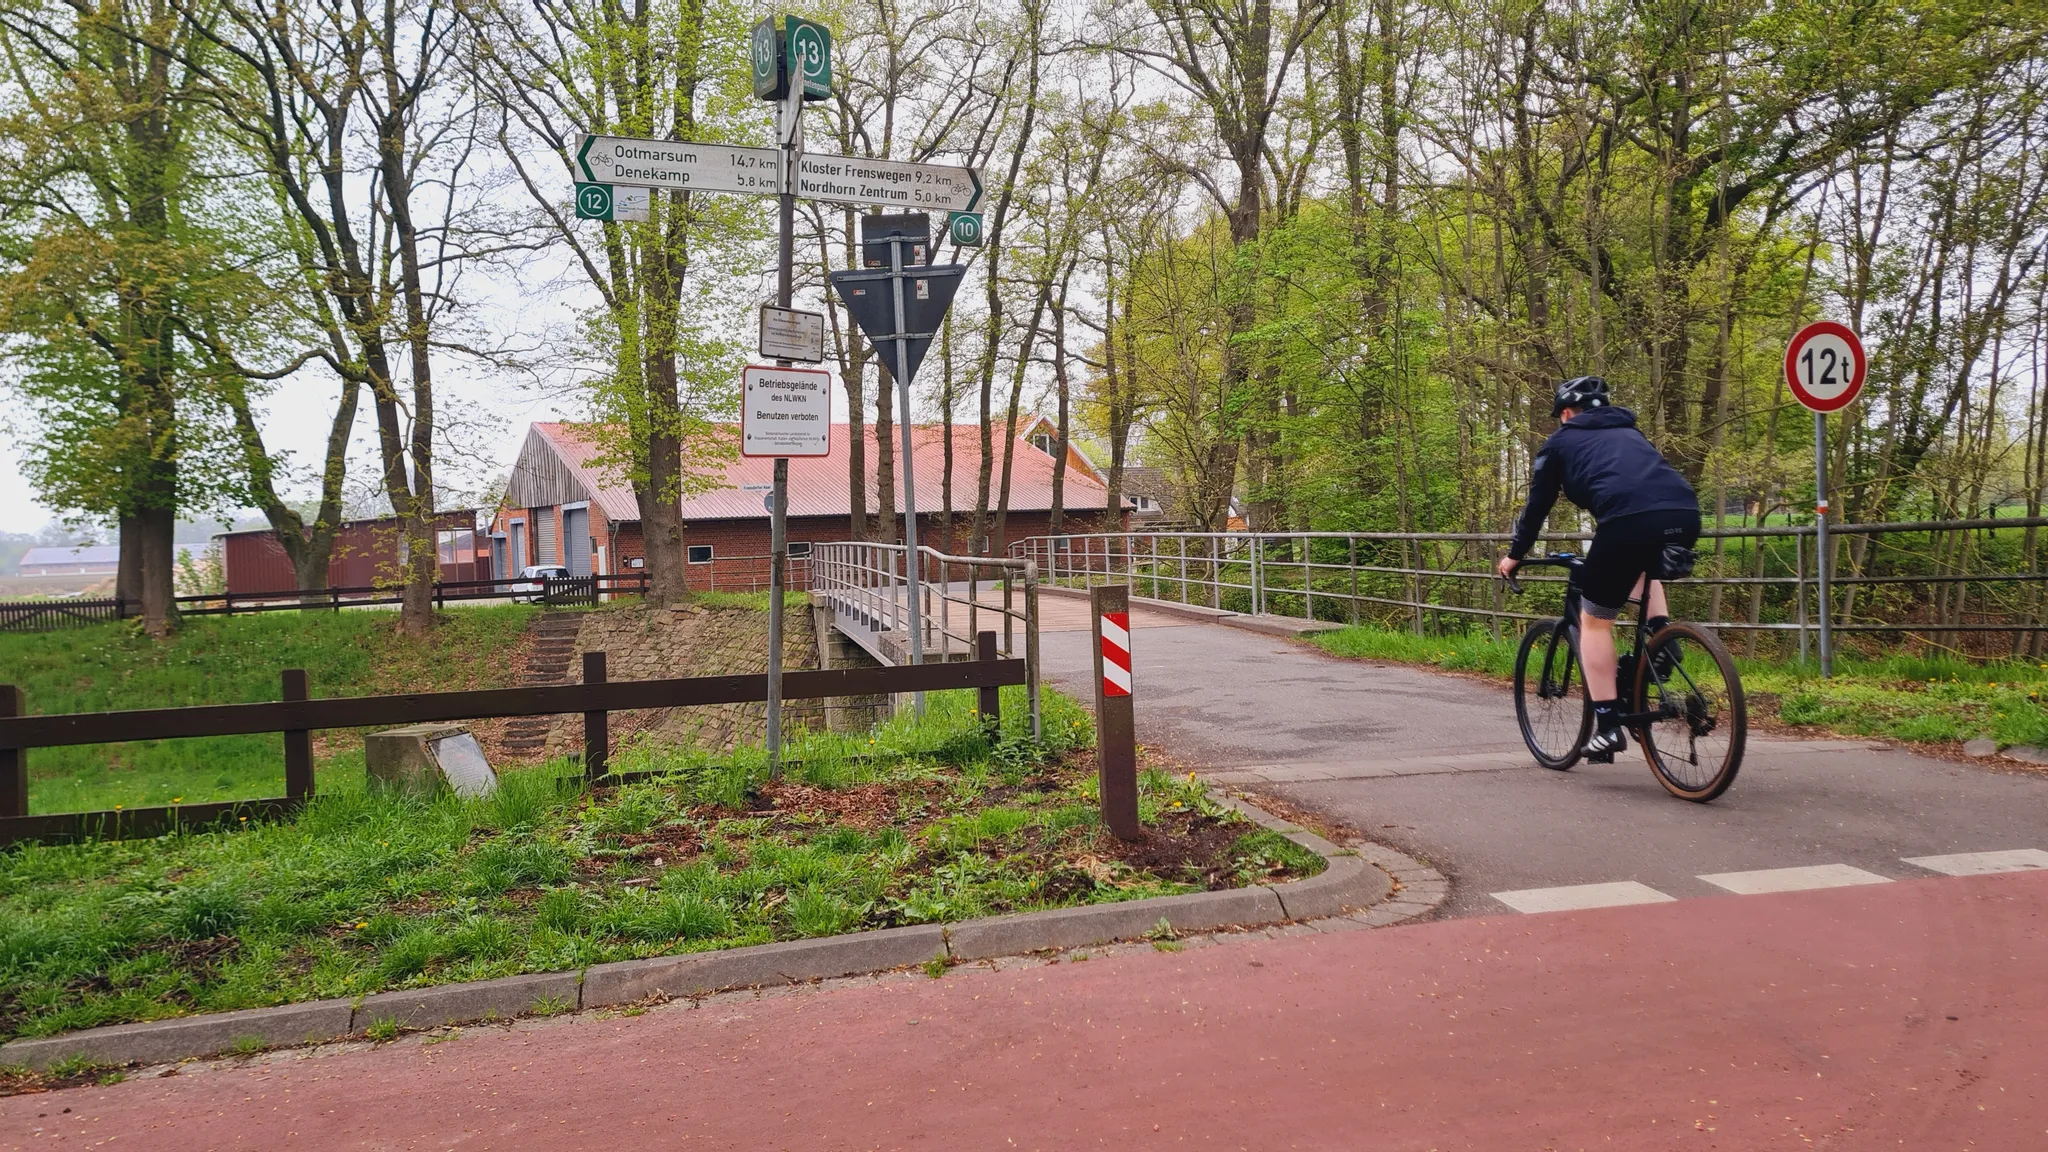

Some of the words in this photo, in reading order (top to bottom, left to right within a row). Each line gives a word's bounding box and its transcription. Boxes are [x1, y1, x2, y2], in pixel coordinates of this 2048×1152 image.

[758, 39, 770, 65] 13
[799, 39, 819, 65] 13
[615, 145, 697, 164] Ootmarsum
[759, 158, 777, 170] km
[615, 164, 691, 185] Denekamp
[759, 176, 777, 189] km
[801, 161, 842, 176] Kloster
[845, 164, 912, 184] Frenswegen
[935, 174, 952, 186] km
[585, 193, 602, 210] 12
[801, 179, 856, 196] Nordhorn
[859, 184, 908, 201] Zentrum
[935, 192, 952, 204] km
[959, 221, 974, 237] 10
[759, 378, 818, 392] Betriebsgelände
[771, 393, 783, 402] des
[783, 394, 807, 403] NLWKN
[757, 410, 789, 421] Benutzen
[791, 412, 819, 421] verboten
